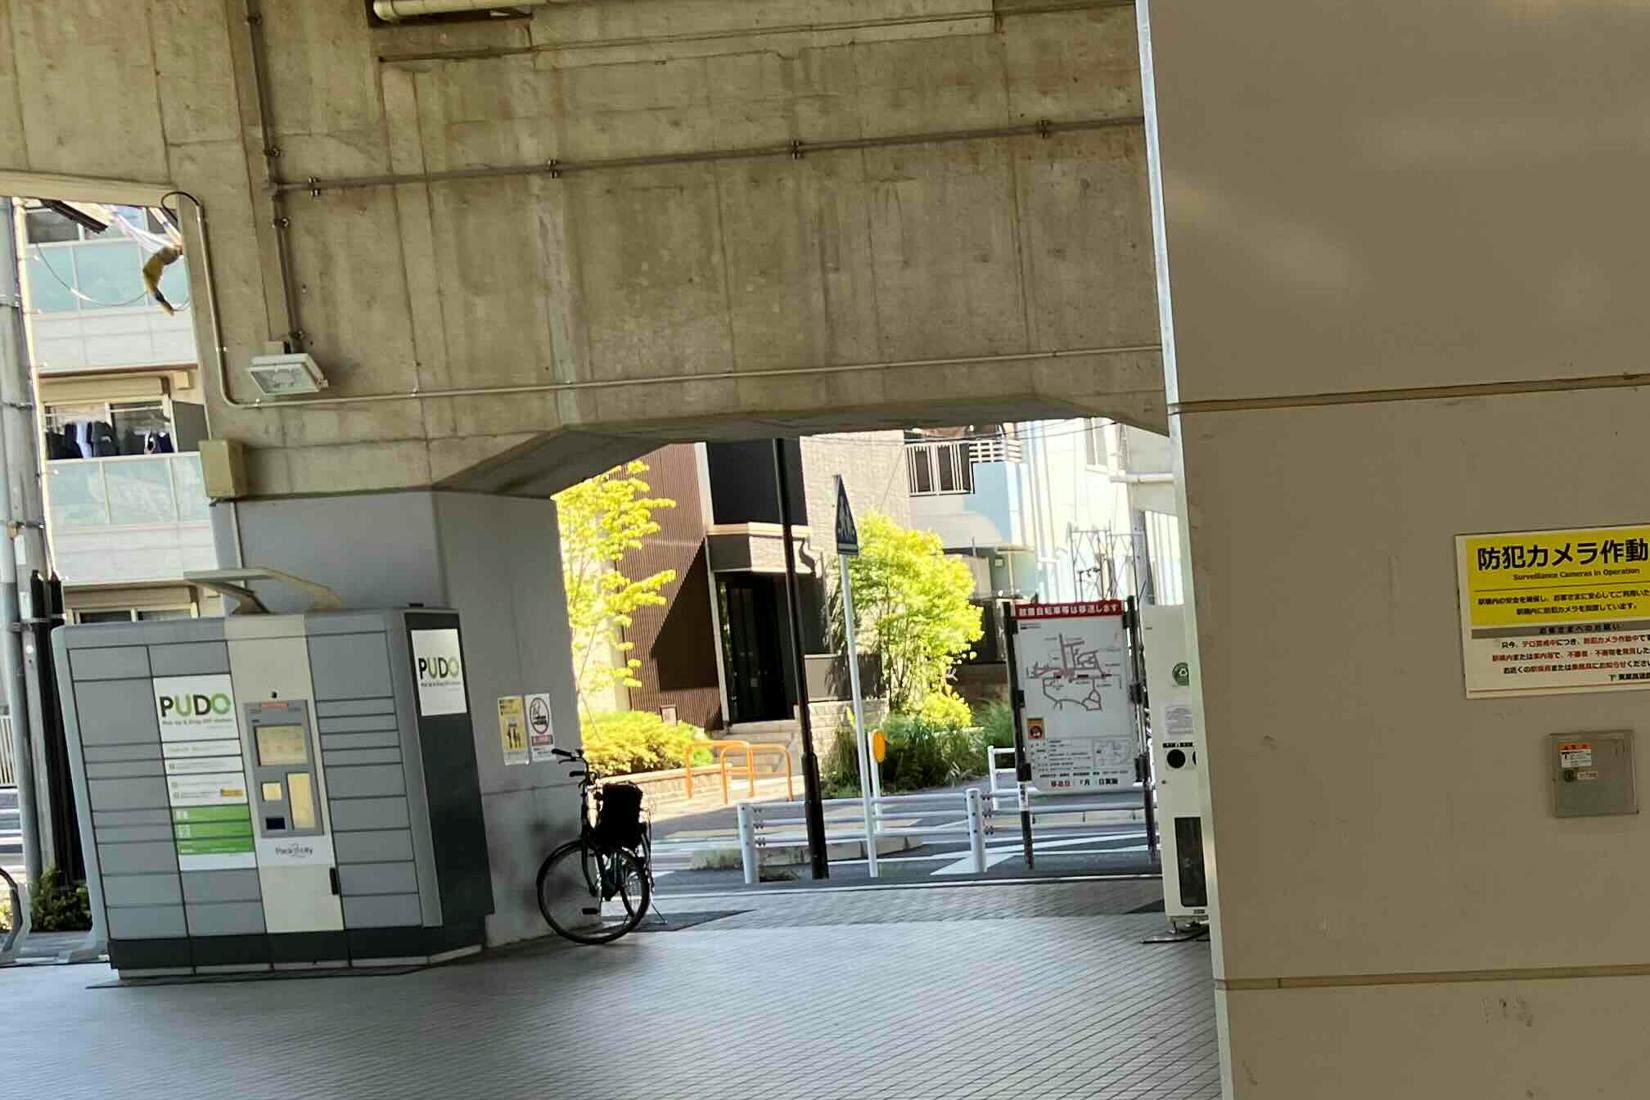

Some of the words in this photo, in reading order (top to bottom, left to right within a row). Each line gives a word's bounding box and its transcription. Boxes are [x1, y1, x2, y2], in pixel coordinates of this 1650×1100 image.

[1513, 572, 1558, 581] Surveillance
[1560, 570, 1592, 579] Cameras
[1603, 567, 1640, 577] Operation
[418, 656, 459, 680] PUDO
[159, 693, 231, 717] PUDO
